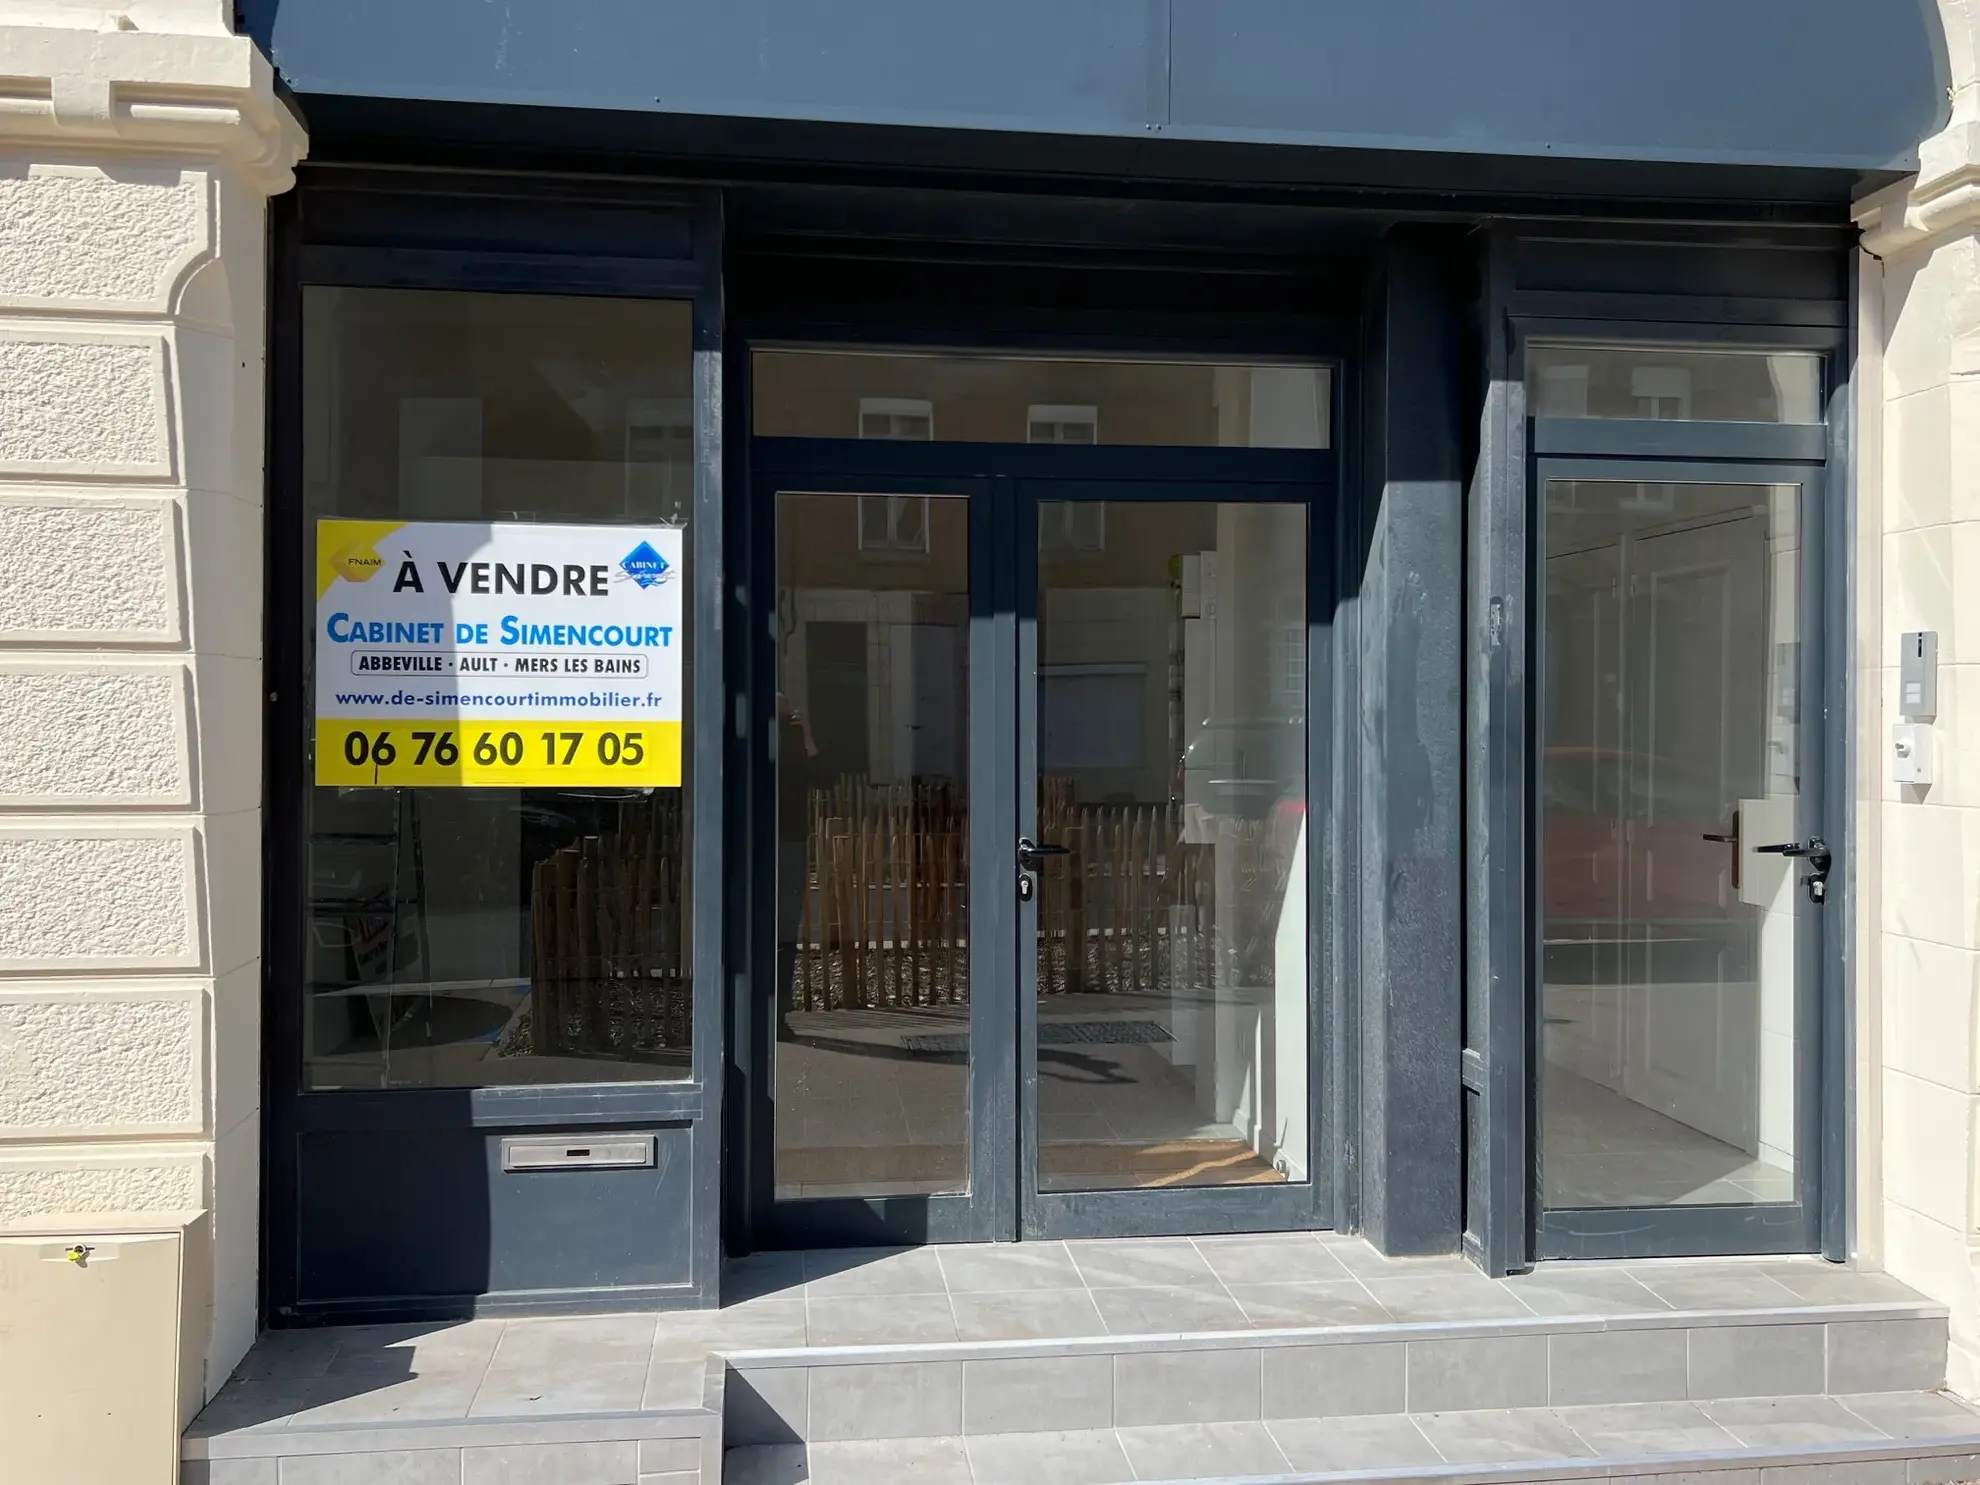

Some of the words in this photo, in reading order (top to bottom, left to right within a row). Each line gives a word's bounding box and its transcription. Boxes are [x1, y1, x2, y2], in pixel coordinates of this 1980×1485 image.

[348, 558, 382, 566] FNAIM
[621, 560, 668, 571] CABINET
[393, 551, 423, 593] À
[437, 561, 609, 596] VENDRE
[359, 656, 442, 671] ABBEVILLE
[460, 657, 498, 672] AULT
[515, 658, 558, 672] MERS
[565, 658, 588, 673] LES
[595, 659, 641, 674] BAINS
[335, 690, 662, 708] www.de-simencourtimmobilier.fr
[344, 731, 396, 766] 06
[411, 731, 459, 767] 76
[473, 731, 524, 766] 60
[541, 731, 583, 765] 17
[597, 732, 644, 766] 05
